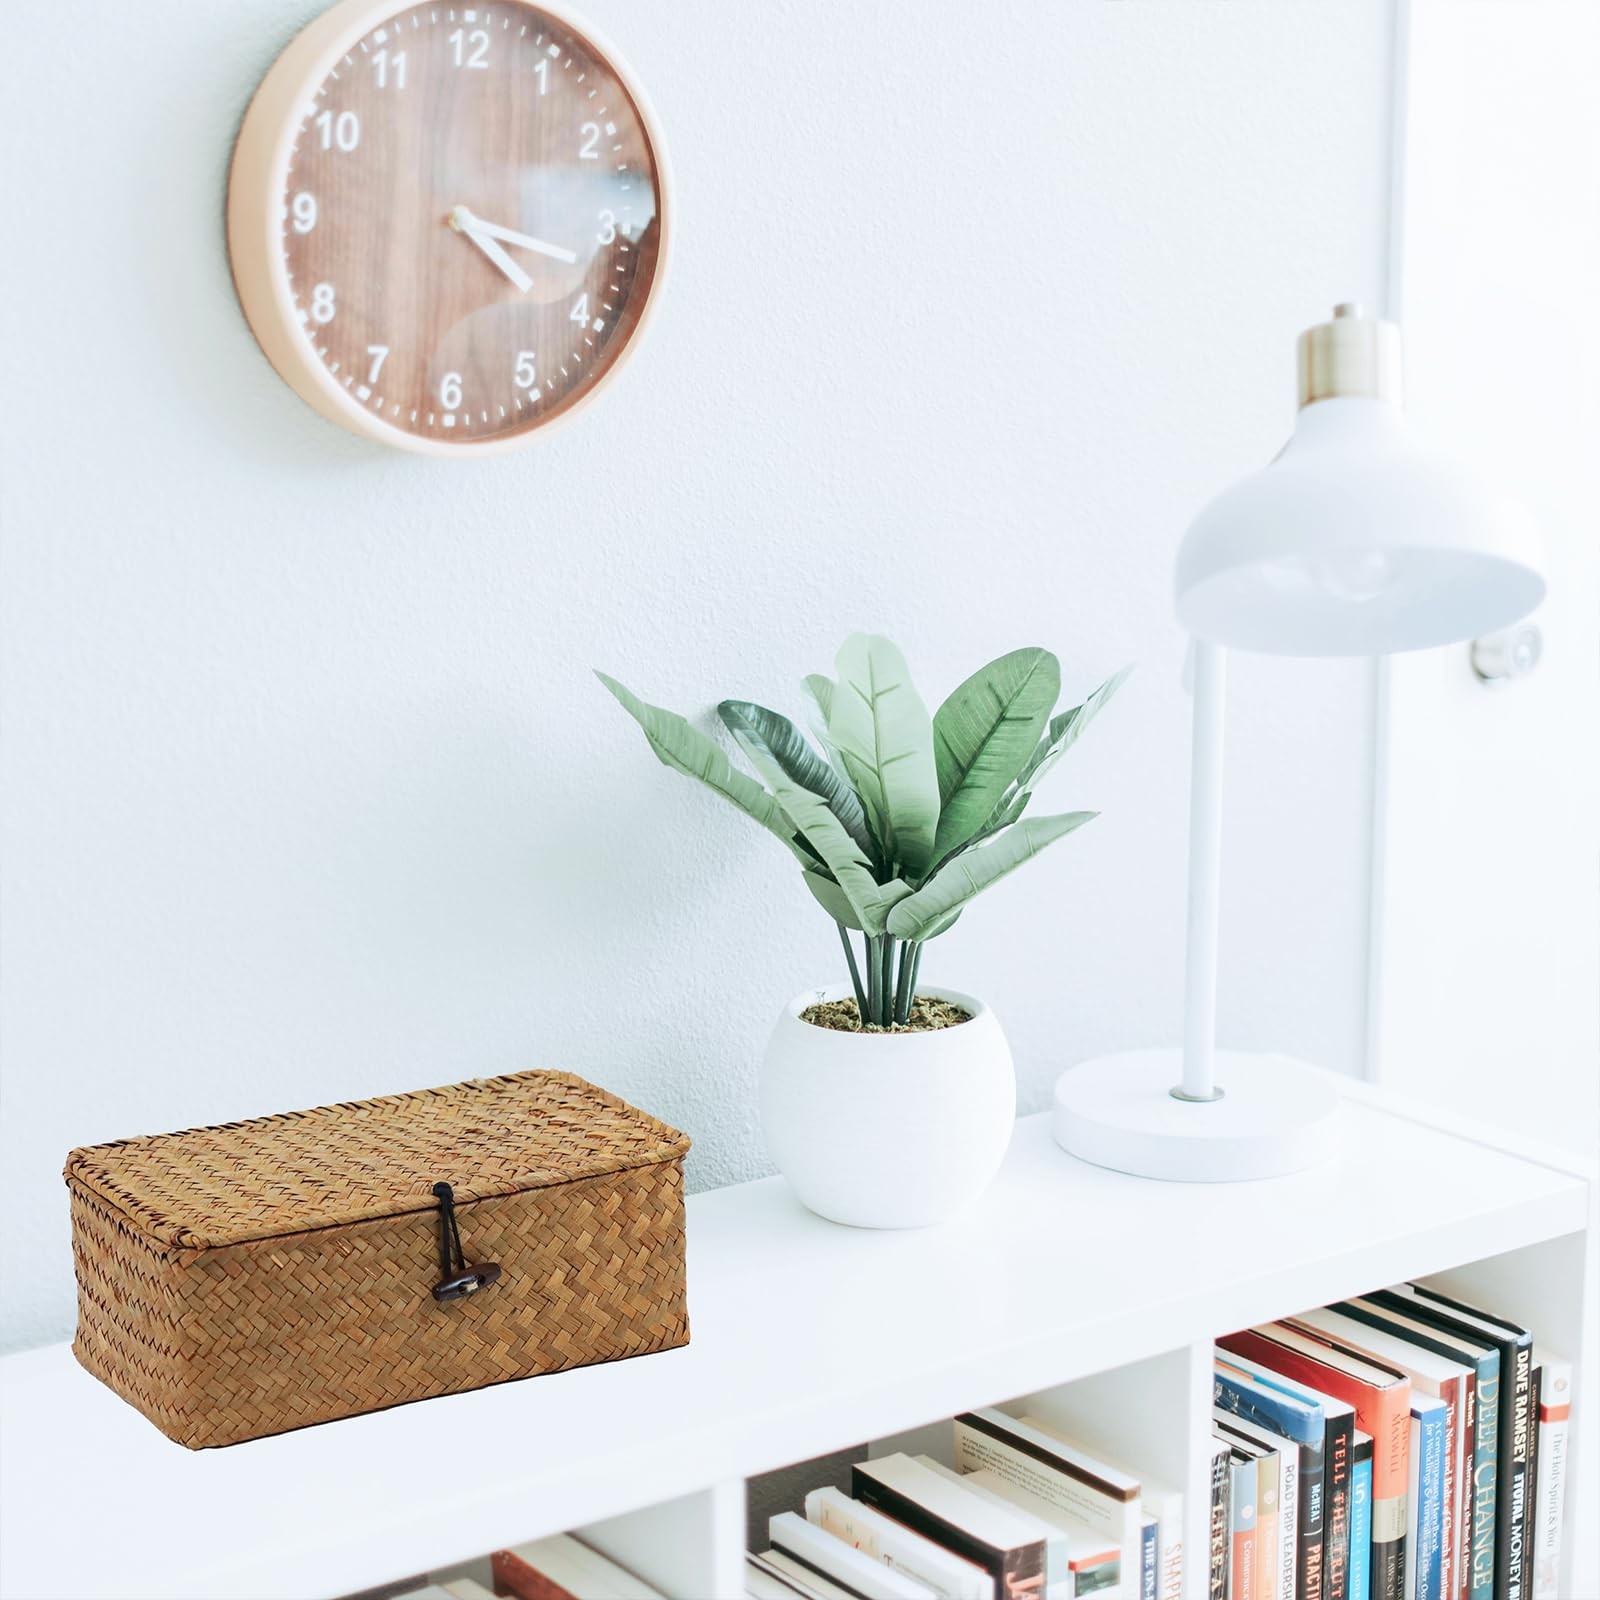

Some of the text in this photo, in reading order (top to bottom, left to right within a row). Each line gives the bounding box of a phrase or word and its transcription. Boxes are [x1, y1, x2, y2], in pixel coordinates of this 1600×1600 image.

[449, 30, 490, 69] 12
[372, 50, 408, 90] 11
[534, 60, 548, 96] 1
[317, 111, 361, 152] 10
[579, 122, 600, 159] 2
[292, 192, 318, 234] 9
[596, 209, 616, 245] 3
[311, 284, 337, 324] 8
[569, 292, 590, 328] 4
[367, 346, 390, 383] 7
[514, 352, 537, 388] 5
[440, 372, 463, 411] 6
[1434, 1420, 1442, 1430] A
[1445, 1402, 1456, 1426] The
[1513, 1349, 1529, 1464] DAVE RAMSEY
[1425, 1423, 1435, 1437] for
[1445, 1427, 1454, 1455] Nuts
[1333, 1434, 1347, 1485] TELL
[1423, 1438, 1434, 1486] Weddings
[1444, 1456, 1453, 1477] and
[1355, 1482, 1366, 1505] 5
[1424, 1487, 1433, 1499] &
[1443, 1477, 1453, 1505] Bolts
[1464, 1454, 1473, 1511] Understanding
[1472, 1374, 1499, 1589] DEEP CHANGE
[1545, 1432, 1564, 1549] The Holy Spirit & You
[1310, 1483, 1321, 1523] McNEAL
[1332, 1491, 1346, 1536] THE
[1422, 1499, 1433, 1541] Funerals
[1442, 1505, 1451, 1516] of
[1511, 1480, 1524, 1524] TOTAL
[1281, 1464, 1296, 1600] ROAD TRIP LEADERSH
[1430, 1501, 1440, 1553] Handbook
[1442, 1515, 1453, 1557] Church
[1144, 1536, 1155, 1569] THE
[1422, 1541, 1430, 1558] and
[1462, 1543, 1469, 1553] of
[1509, 1524, 1523, 1584] MONEY
[1306, 1544, 1321, 1600] PRACTI
[1387, 1555, 1396, 1597] LAWS OF
[1508, 1584, 1521, 1600] M
